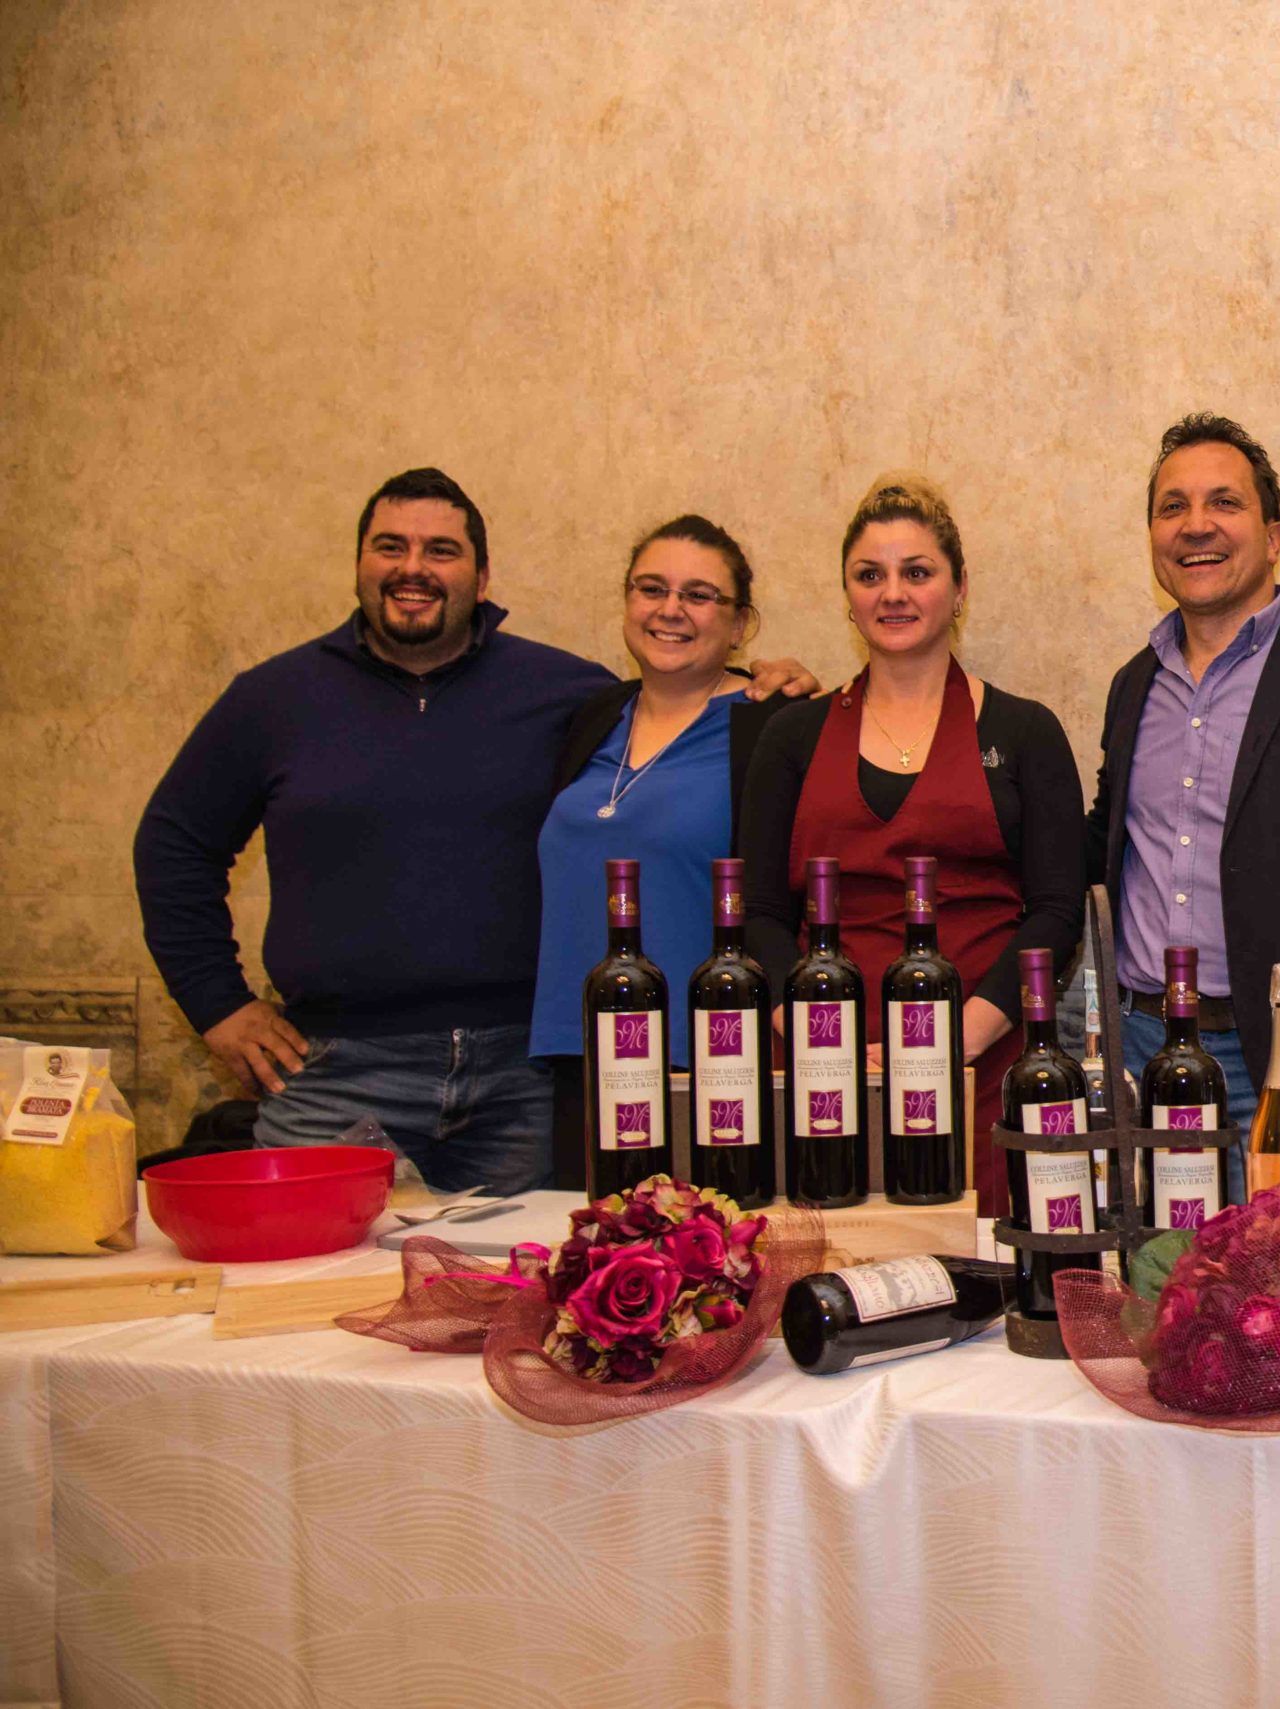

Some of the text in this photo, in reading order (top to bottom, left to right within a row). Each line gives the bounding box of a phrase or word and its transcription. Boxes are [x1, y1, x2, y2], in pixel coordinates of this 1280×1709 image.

[799, 1069, 851, 1078] PELAVERGA
[894, 1069, 945, 1078] PELAVERGA
[605, 1081, 659, 1090] PELAVERGA
[700, 1078, 753, 1087] PELAVERGA
[1034, 1173, 1088, 1184] PELAVERGA
[1159, 1177, 1213, 1185] PELAVERGA
